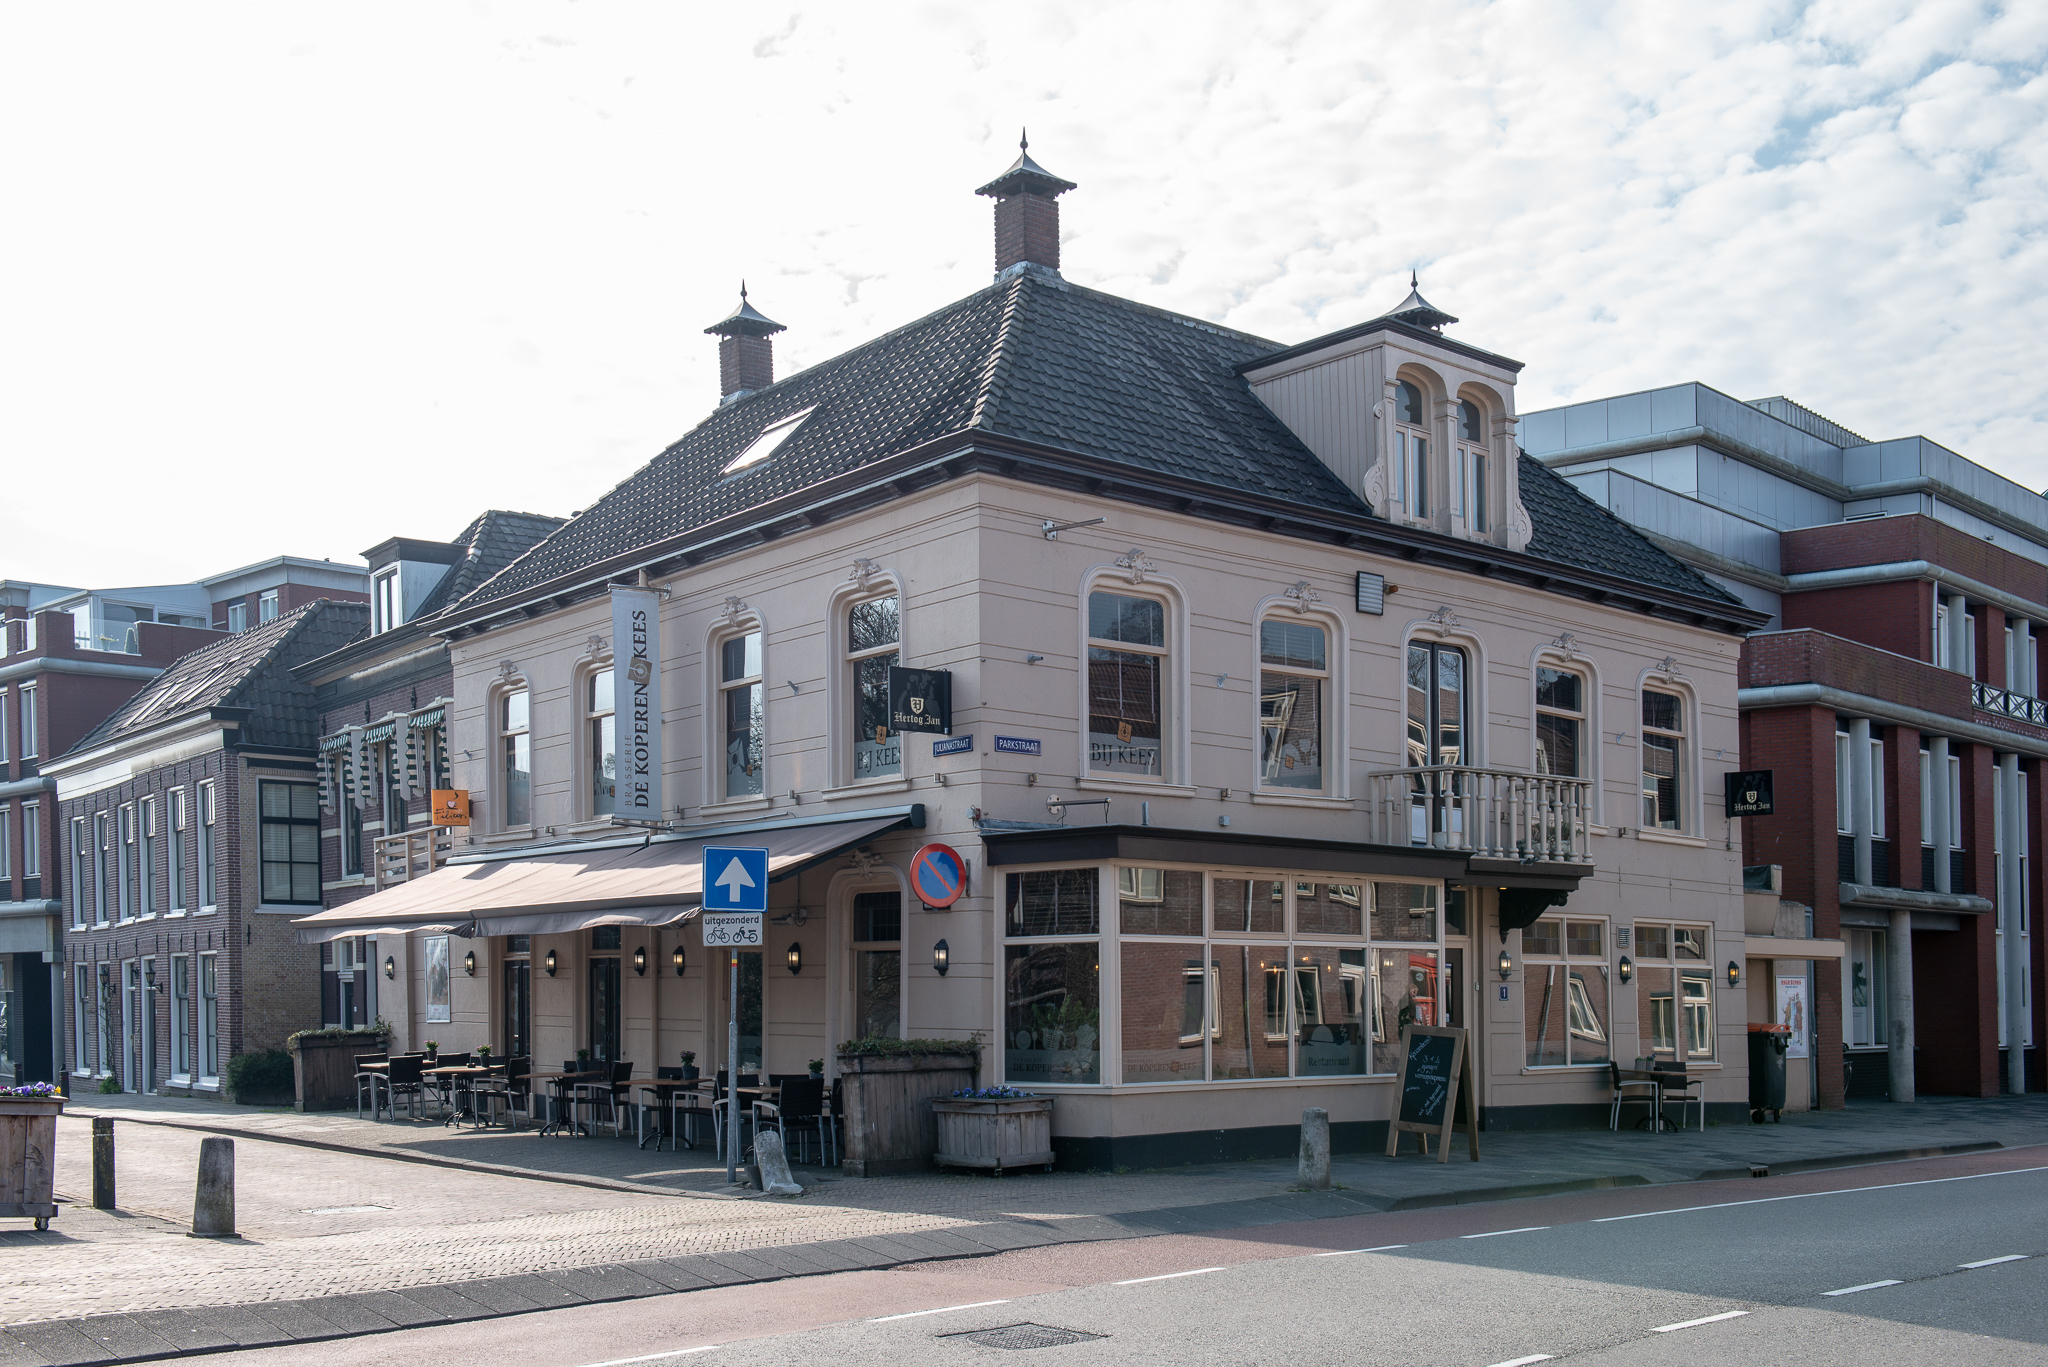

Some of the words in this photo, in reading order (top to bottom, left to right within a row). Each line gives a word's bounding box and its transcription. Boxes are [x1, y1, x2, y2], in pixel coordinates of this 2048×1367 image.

[631, 609, 647, 660] KEES
[893, 711, 924, 726] Hertog
[924, 714, 941, 728] Jan
[634, 681, 649, 777] KOPEREN
[934, 738, 969, 755] JULIANASTRAAT
[999, 739, 1038, 751] PARKSTRAAT
[856, 750, 873, 773] BIJ
[1090, 742, 1113, 767] BIJ
[1117, 746, 1156, 767] KEES
[624, 734, 632, 807] BRASSERIE
[634, 781, 649, 809] DE
[1733, 803, 1757, 812] Hertog
[1757, 802, 1771, 810] Jan
[704, 915, 760, 927] uitgezonderd
[1013, 1063, 1024, 1072] DE
[1127, 1064, 1138, 1073] DE
[1139, 1063, 1171, 1073] KOPEREN
[1179, 1061, 1196, 1071] KEES
[1308, 1056, 1350, 1067] Restaurant
